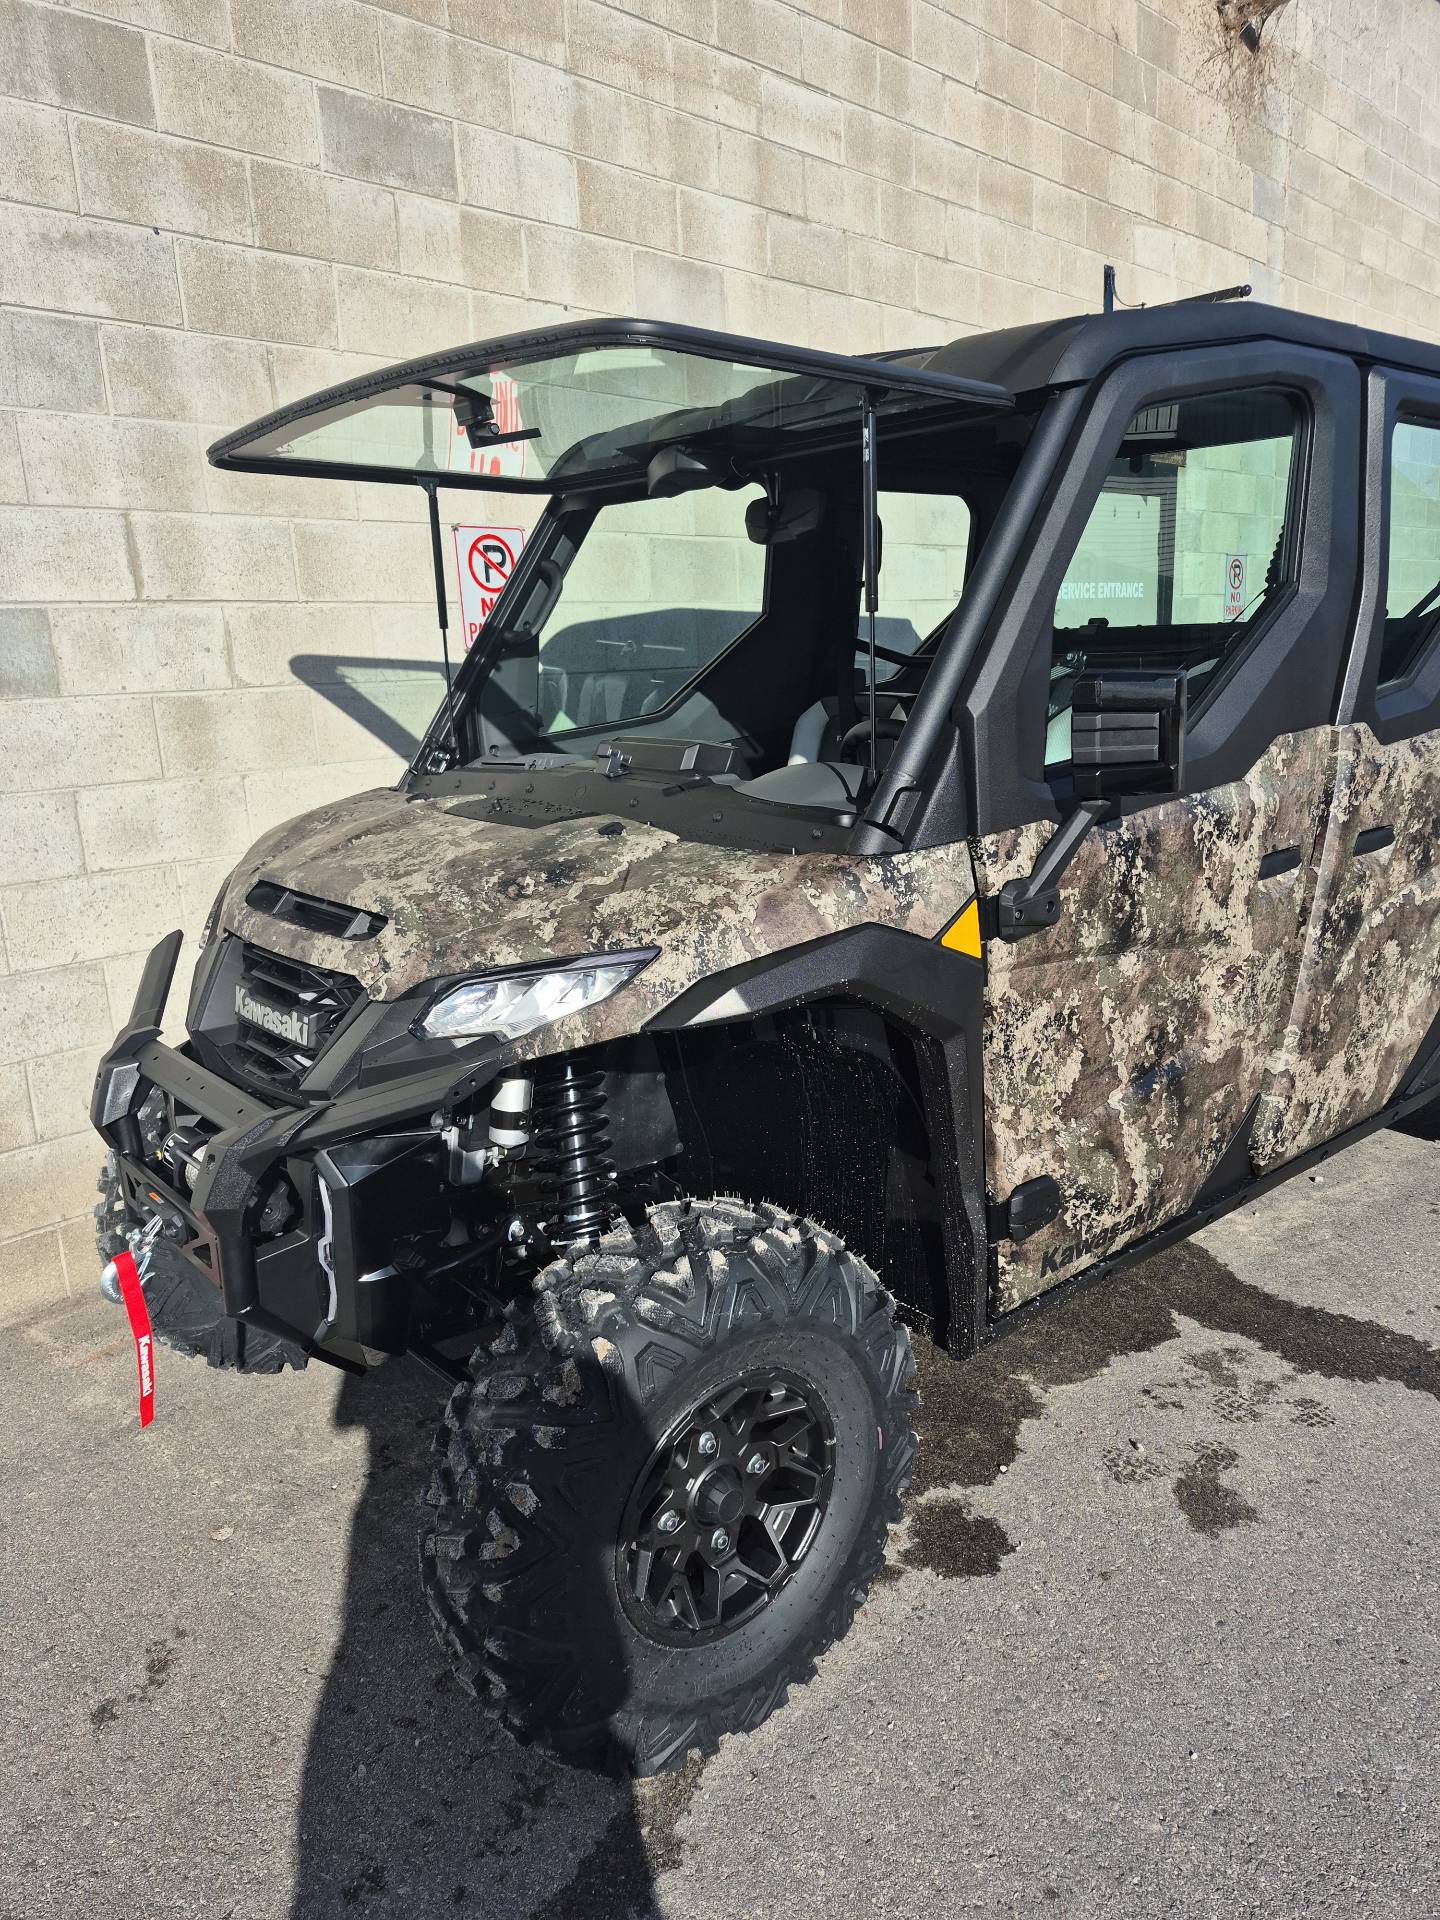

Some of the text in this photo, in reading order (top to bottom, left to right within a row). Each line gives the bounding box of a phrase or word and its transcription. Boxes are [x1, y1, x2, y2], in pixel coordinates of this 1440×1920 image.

[1098, 582, 1144, 599] ENTRANCE
[1230, 592, 1241, 602] NO
[481, 597, 494, 617] N
[235, 985, 309, 1047] Kawasaki
[138, 1334, 153, 1398] Kawasaki
